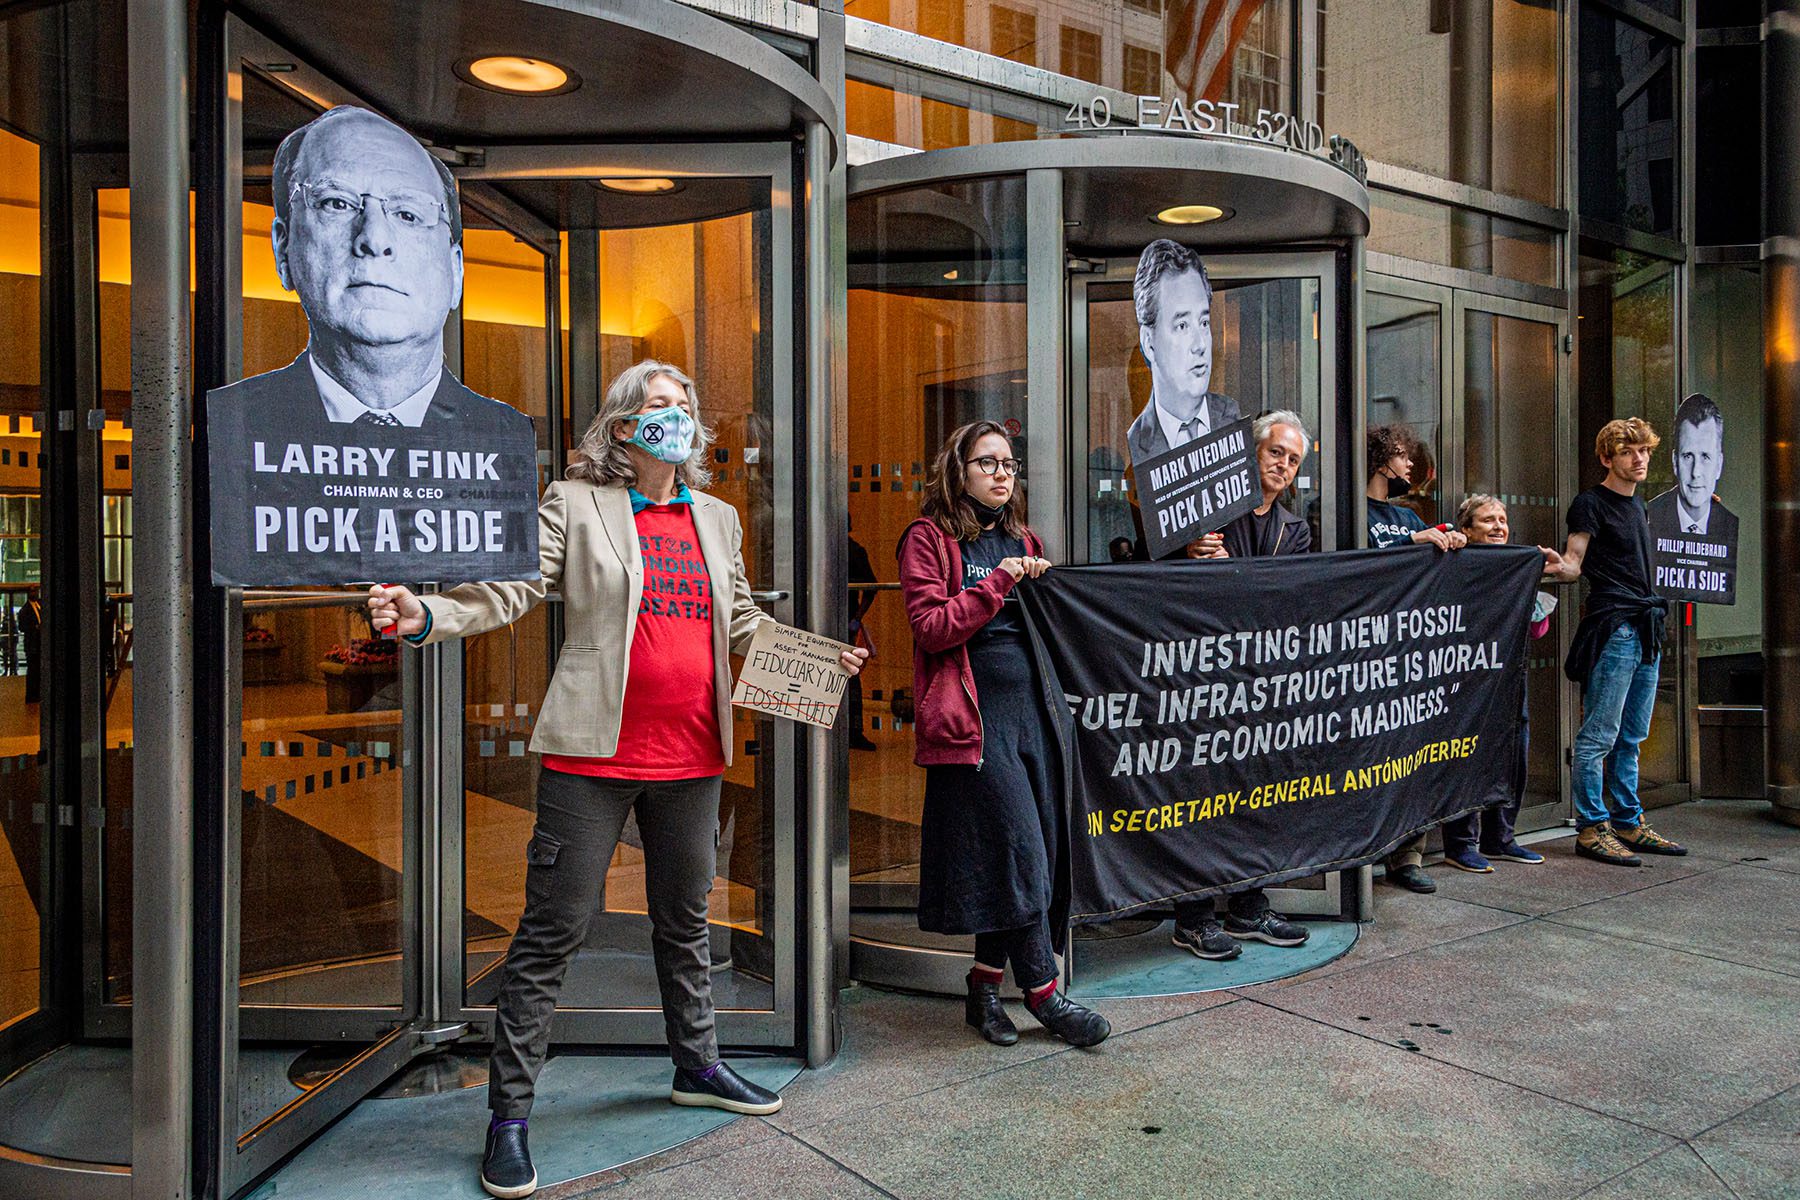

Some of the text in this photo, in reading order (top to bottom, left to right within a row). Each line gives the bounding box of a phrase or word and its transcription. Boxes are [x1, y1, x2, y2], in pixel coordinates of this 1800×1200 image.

[1064, 95, 1324, 153] 40 EAST 52ND
[254, 441, 501, 481] LARRY FINK
[1149, 429, 1246, 492] MARK WIEDMAN
[323, 484, 443, 499] CHAIRMAN & CEO
[1154, 495, 1167, 505] HEAD
[1208, 465, 1230, 479] CORPORATE
[1157, 468, 1252, 539] PICK A SIDE
[254, 505, 504, 553] PICK A SIDE
[1657, 538, 1727, 558] PHILLIP HILDEBRAND
[1656, 566, 1726, 592] PICK A SIDE
[639, 596, 709, 620] DEATH
[773, 642, 798, 655] ASSET
[774, 626, 842, 651] SIMPLE EQUATION
[797, 641, 809, 649] FOR
[1141, 604, 1466, 678] INVESTING IN NEW FOSSIL
[752, 650, 849, 696] FIDUCIARY DUTY
[1157, 655, 1399, 725] INFRASTRUCTURE
[1404, 650, 1423, 683] IS
[1428, 641, 1504, 678] MORAL
[742, 685, 836, 726] FOSSIL FUELS
[1111, 682, 1460, 777] AND ECONOMIC MADNESS."
[1109, 772, 1336, 833] SECRETARY-GENERAL
[1342, 754, 1414, 793] ANTÓNIO
